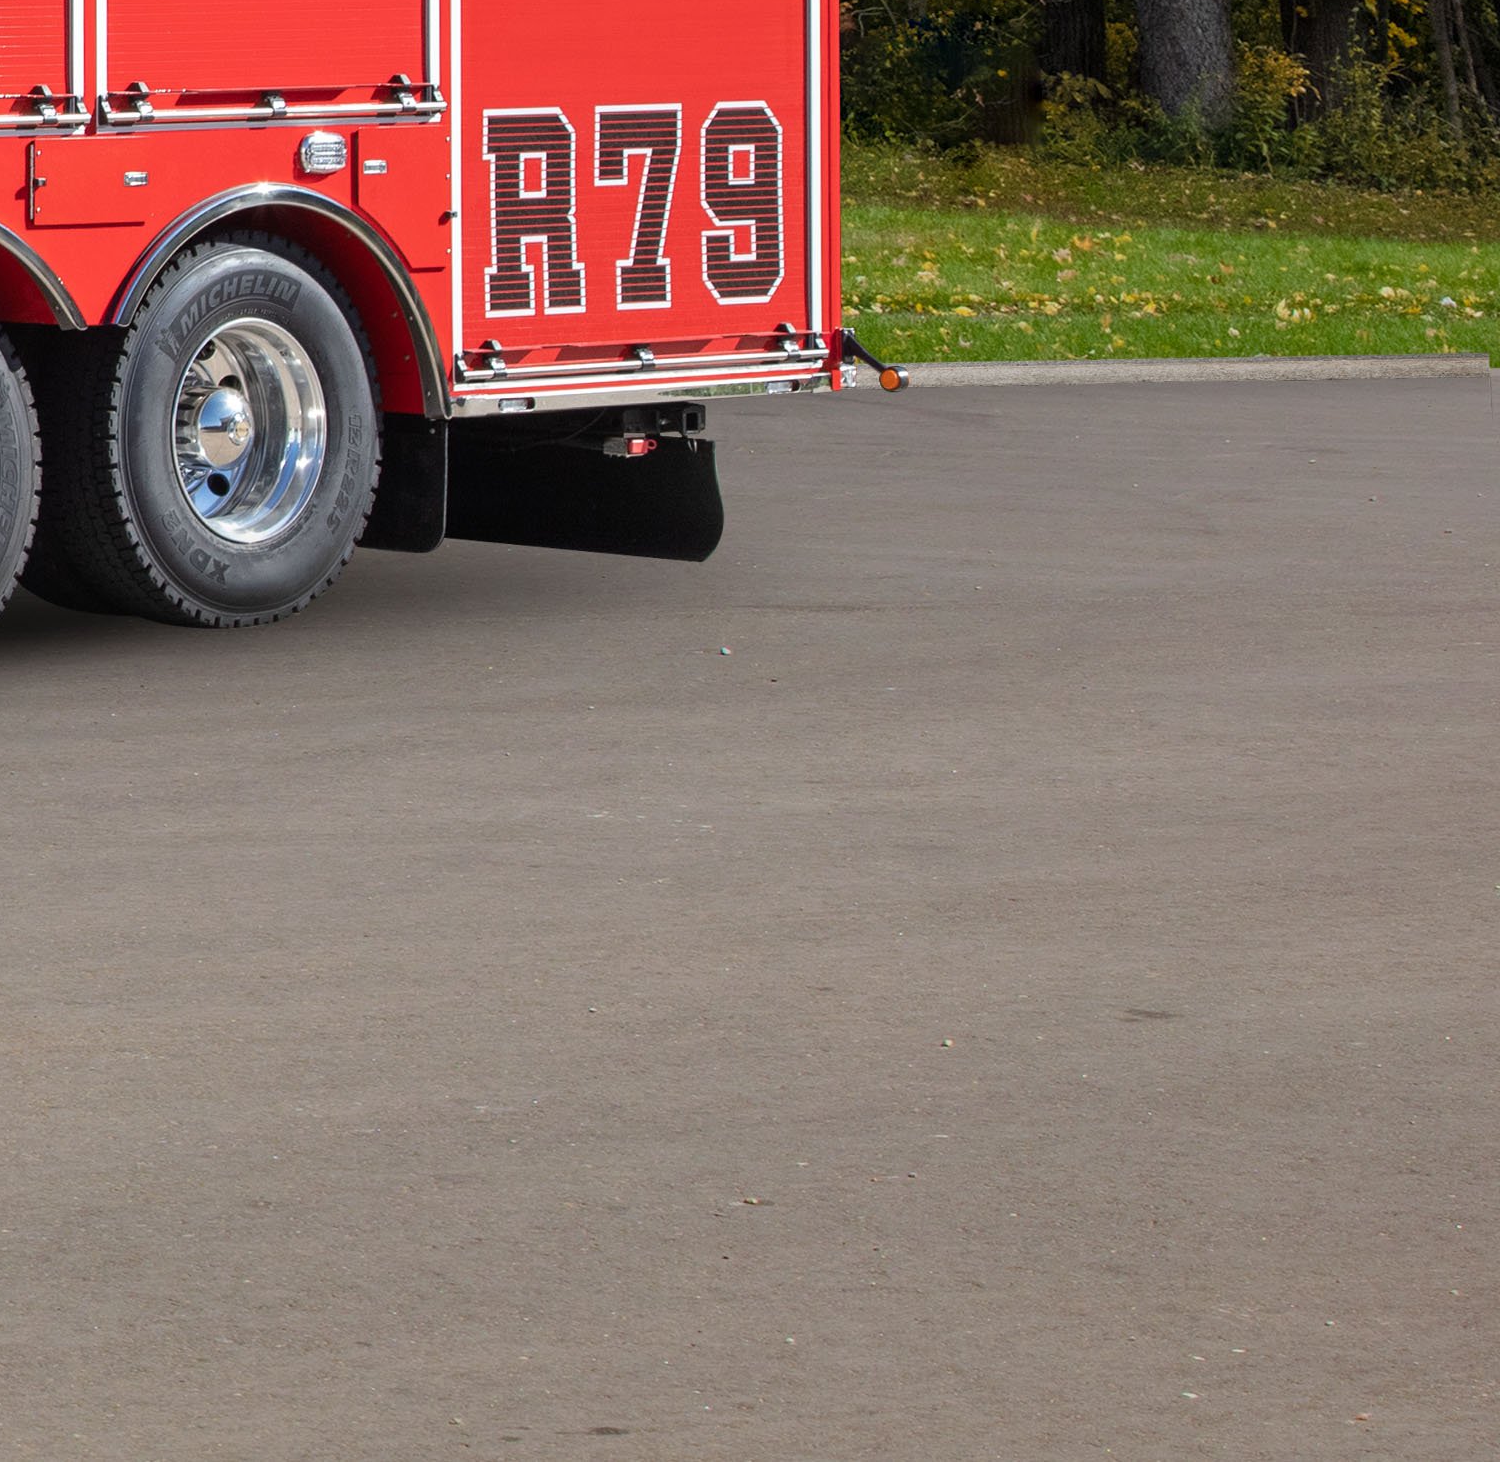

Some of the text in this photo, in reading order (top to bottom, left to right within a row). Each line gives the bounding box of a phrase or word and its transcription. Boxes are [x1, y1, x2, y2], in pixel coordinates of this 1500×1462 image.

[482, 100, 783, 318] R79
[180, 274, 298, 338] MICHELIN
[160, 509, 230, 584] XDN2
